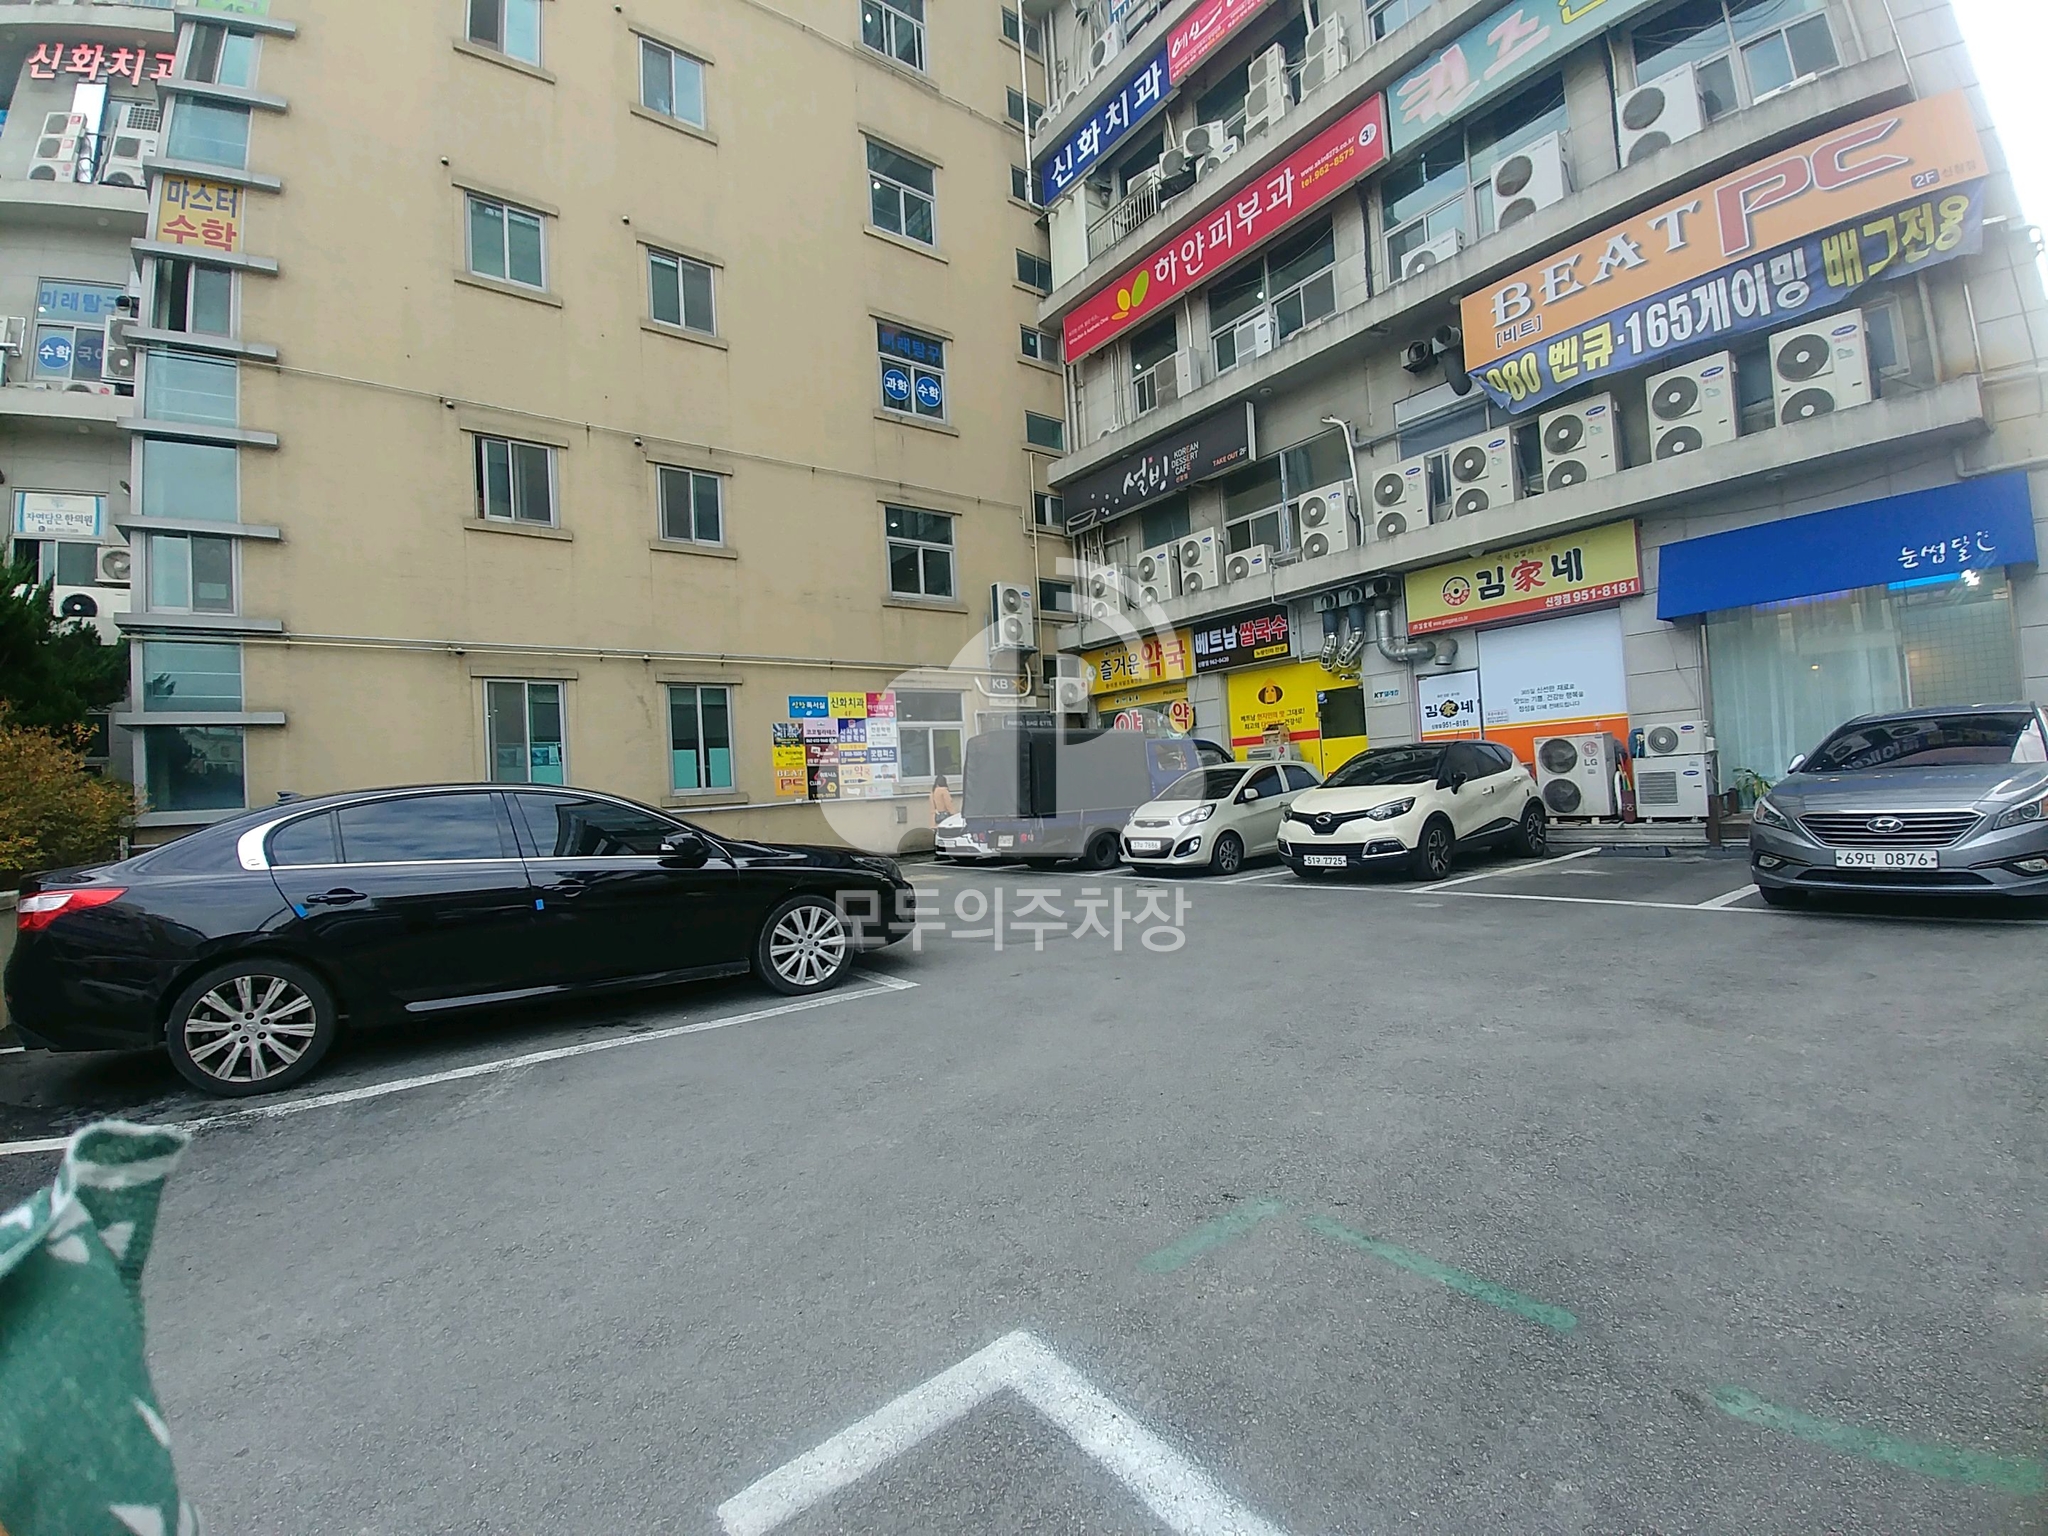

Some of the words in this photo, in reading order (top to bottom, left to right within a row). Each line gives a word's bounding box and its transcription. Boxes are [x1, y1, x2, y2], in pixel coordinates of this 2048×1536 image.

[1051, 60, 1162, 187] 신화치과
[1914, 171, 1935, 187] 2F
[166, 179, 238, 218] 마스터
[1154, 167, 1295, 286] 하얀피부과
[1490, 200, 1701, 329] BEAT
[1714, 117, 1910, 257] PC
[162, 214, 237, 252] 수학
[1480, 352, 1541, 402] 080
[1821, 195, 1969, 288] 배그전용
[39, 344, 72, 361] 수학
[885, 377, 908, 394] 과학
[918, 384, 939, 400] 수학
[1174, 441, 1199, 459] KOREAN
[1212, 455, 1227, 467] TAKE
[1227, 450, 1239, 460] OUT
[1239, 446, 1247, 456] 2F
[1171, 450, 1198, 469] DESSERT
[1123, 453, 1169, 497] 설빙
[27, 512, 64, 525] 자연담은
[65, 513, 93, 527] 한의원
[1897, 535, 1972, 570] 눈썹달
[1572, 581, 1636, 603] 951-8181
[1194, 625, 1237, 655] 베트남
[1239, 614, 1289, 647] 쌀국수
[1101, 653, 1140, 681] 즐거운
[1141, 639, 1186, 677] 약국
[992, 678, 1009, 689] KB
[1537, 685, 1555, 693] 신선한
[831, 697, 864, 708] 신화치과
[1547, 693, 1564, 701] 건강한
[1173, 703, 1190, 730] 약
[1241, 714, 1256, 722] 베트남
[1287, 707, 1305, 716] 그대로!
[1245, 722, 1259, 730] 최고의
[1442, 719, 1469, 728] 951-8181
[1584, 758, 1598, 766] LG
[1323, 857, 1343, 866] 7725
[1884, 853, 1928, 866] 0876
